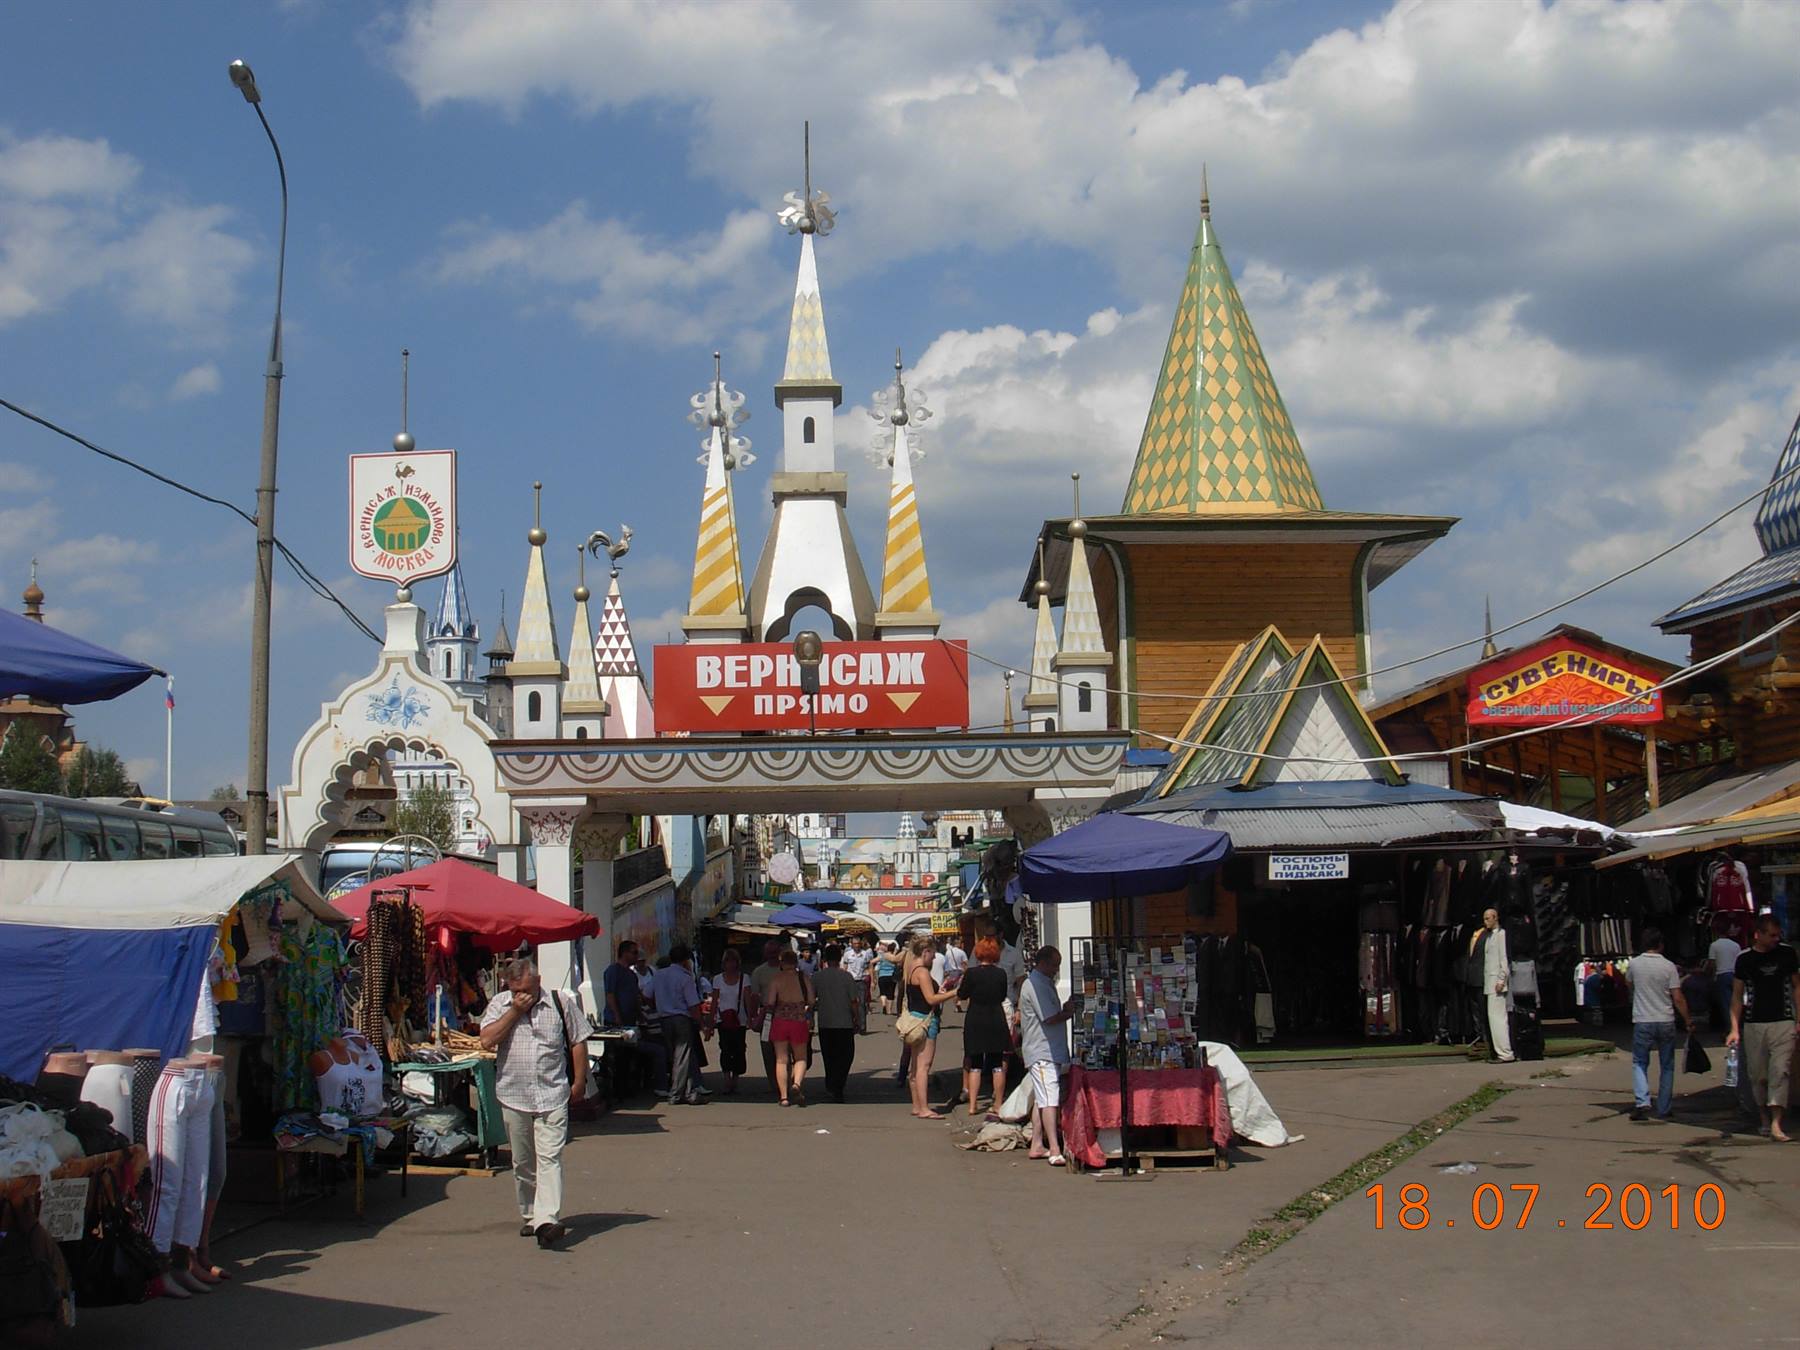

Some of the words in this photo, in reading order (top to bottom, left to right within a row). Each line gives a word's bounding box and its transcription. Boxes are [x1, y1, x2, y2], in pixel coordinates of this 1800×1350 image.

[373, 548, 435, 571] МОСКВА
[1486, 654, 1657, 701] СУВЕНИРЫ
[754, 693, 869, 715] ПРЯМО
[1272, 855, 1346, 863] КОСТЮМЫ
[1274, 870, 1343, 878] ПИДЖАКИ
